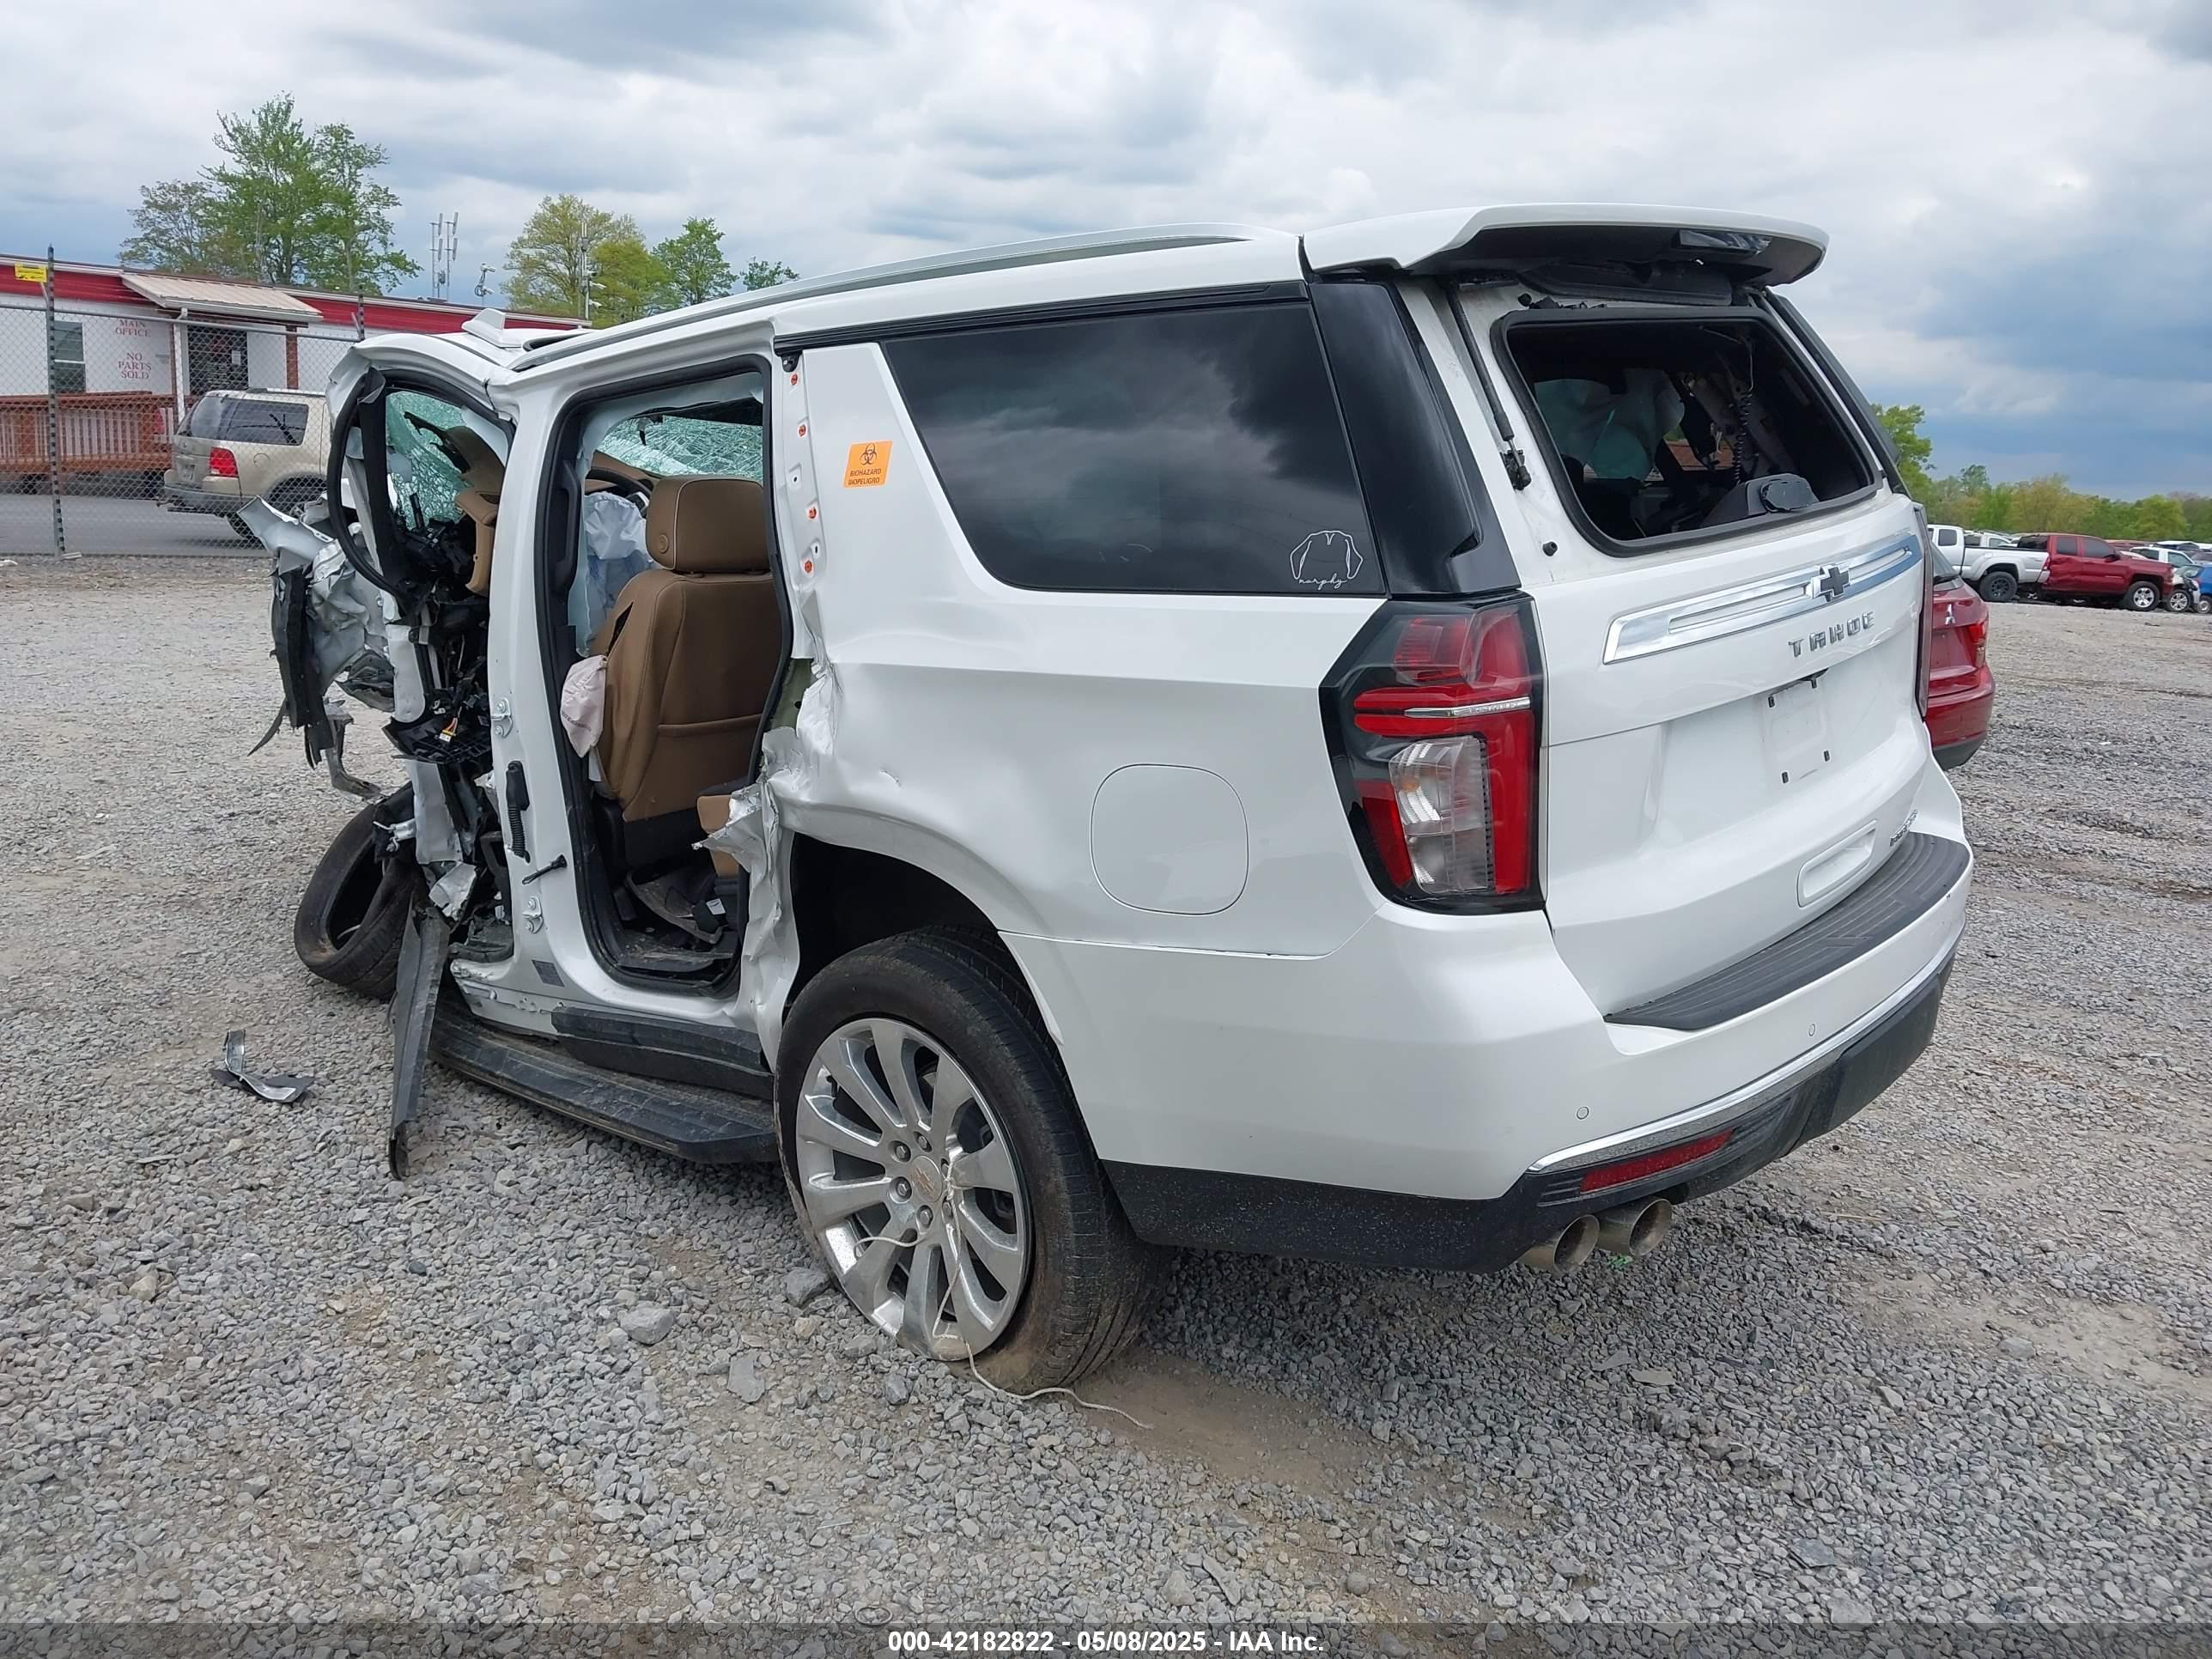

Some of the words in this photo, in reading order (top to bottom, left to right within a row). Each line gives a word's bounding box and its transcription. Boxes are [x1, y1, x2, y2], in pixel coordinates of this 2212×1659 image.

[119, 319, 145, 328] MAIN
[115, 327, 151, 337] OFFICE
[126, 352, 143, 361] NO
[118, 361, 152, 371] PARTS
[849, 468, 882, 477] BIOHAZARD
[1788, 611, 1874, 658] TAHOE
